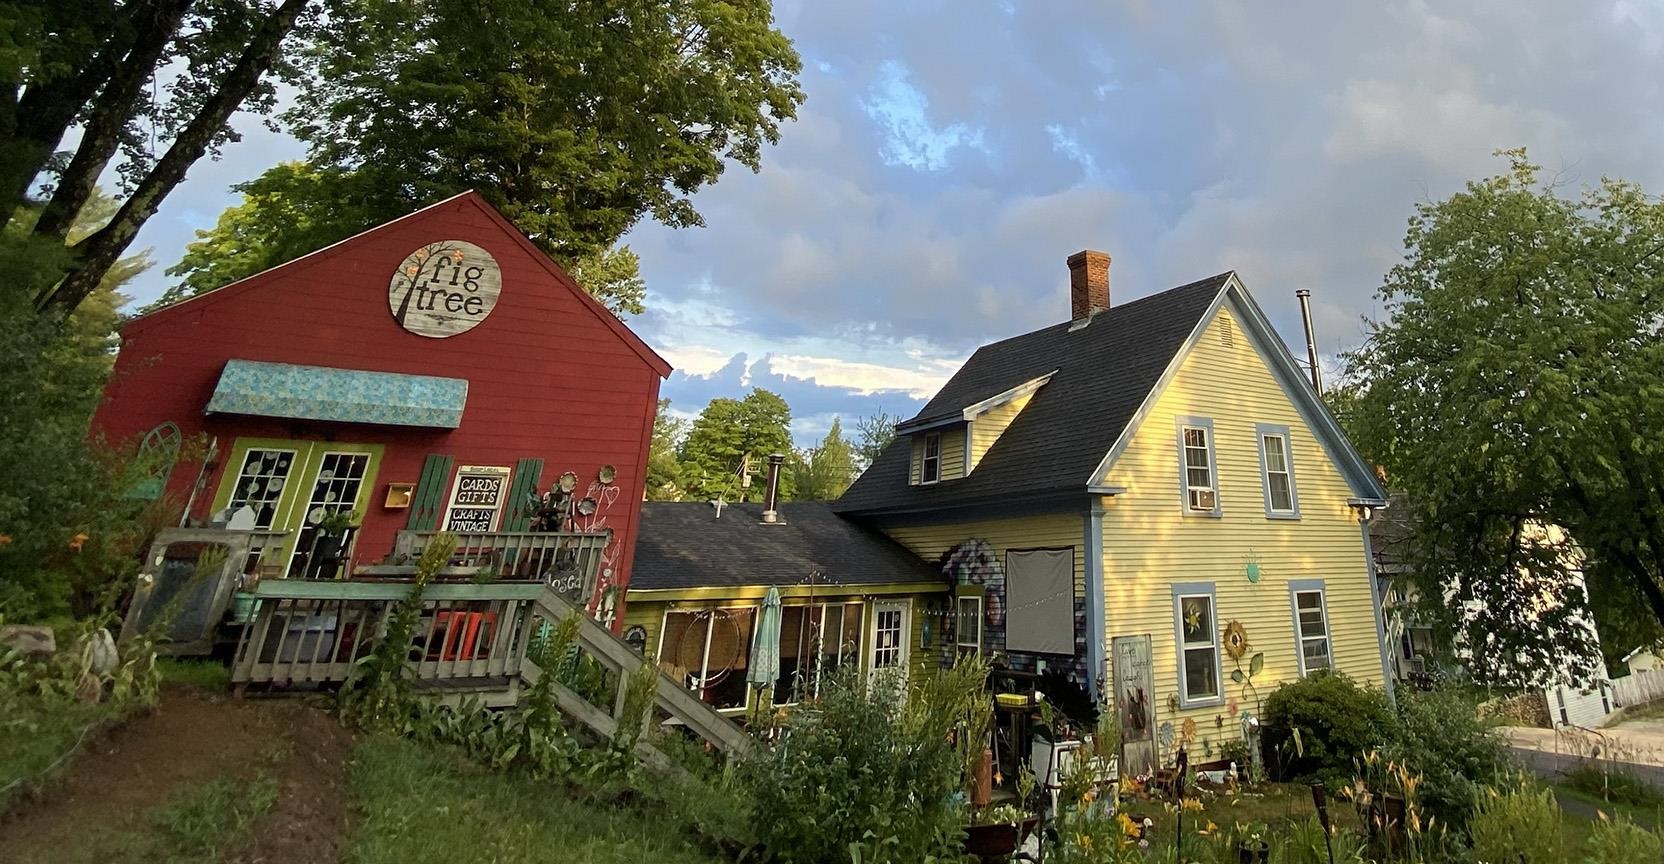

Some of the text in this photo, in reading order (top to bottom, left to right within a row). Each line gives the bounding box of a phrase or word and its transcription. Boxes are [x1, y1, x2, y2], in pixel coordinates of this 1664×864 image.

[430, 255, 485, 292] fig
[416, 280, 484, 316] tree
[461, 478, 500, 492] CARDS
[457, 491, 497, 503] GIFTS
[452, 509, 492, 520] CRAFTS
[450, 520, 489, 532] VINTAGE
